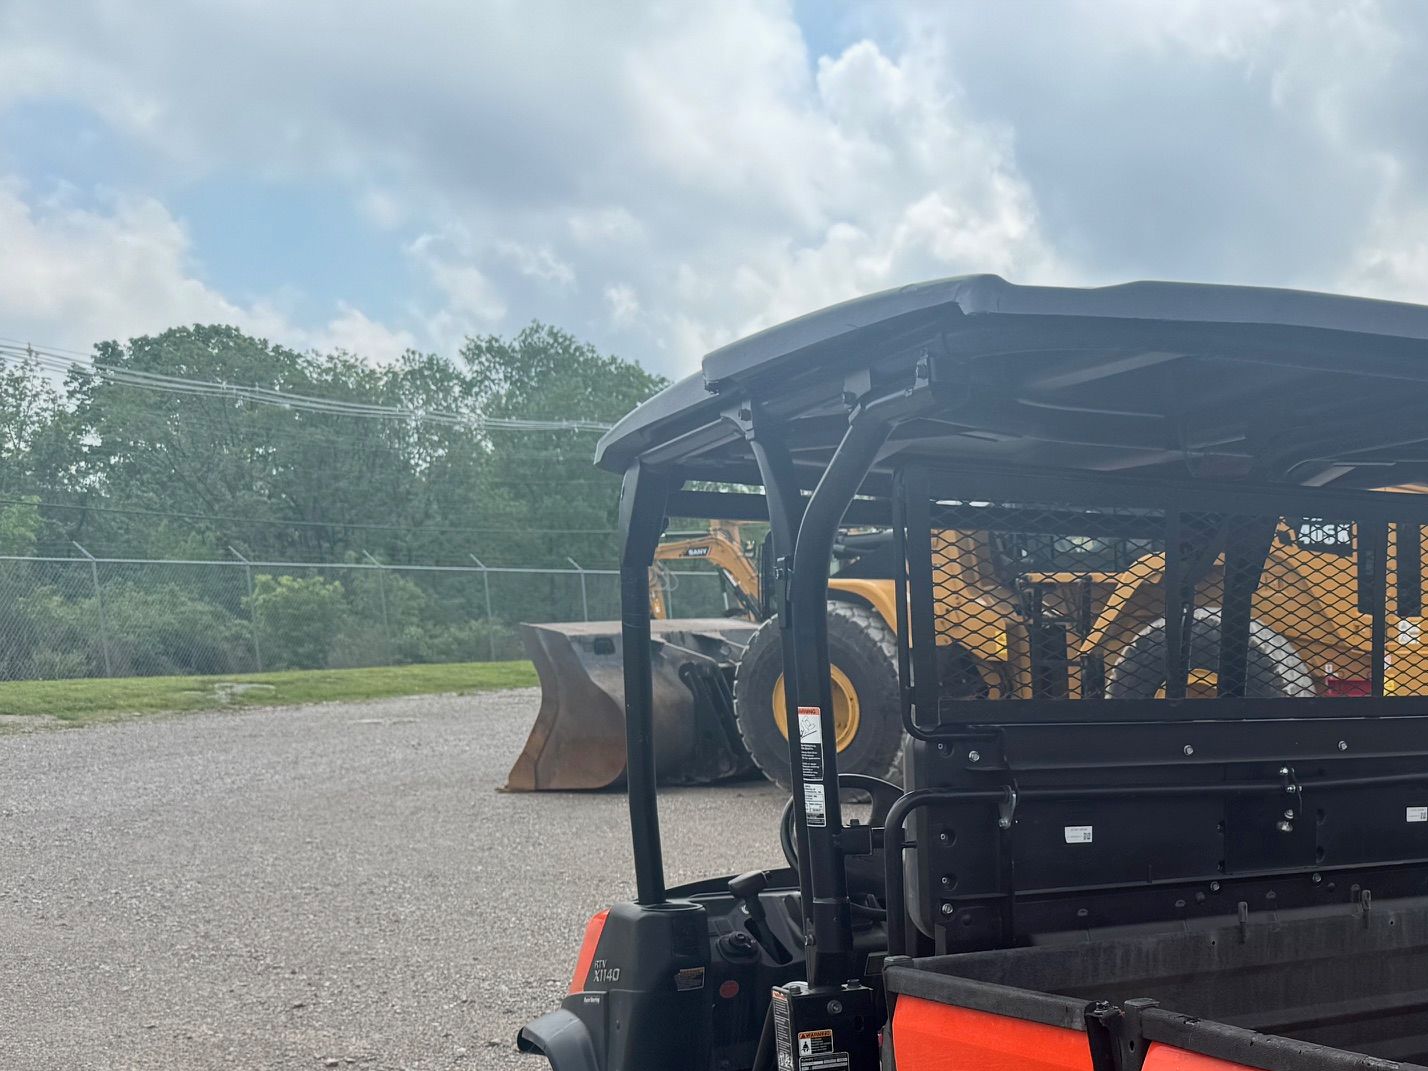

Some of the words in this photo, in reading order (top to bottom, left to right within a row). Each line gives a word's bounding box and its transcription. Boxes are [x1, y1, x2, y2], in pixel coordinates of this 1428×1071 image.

[688, 547, 707, 556] SANY
[594, 959, 607, 968] RTV
[593, 968, 620, 982] X1140
